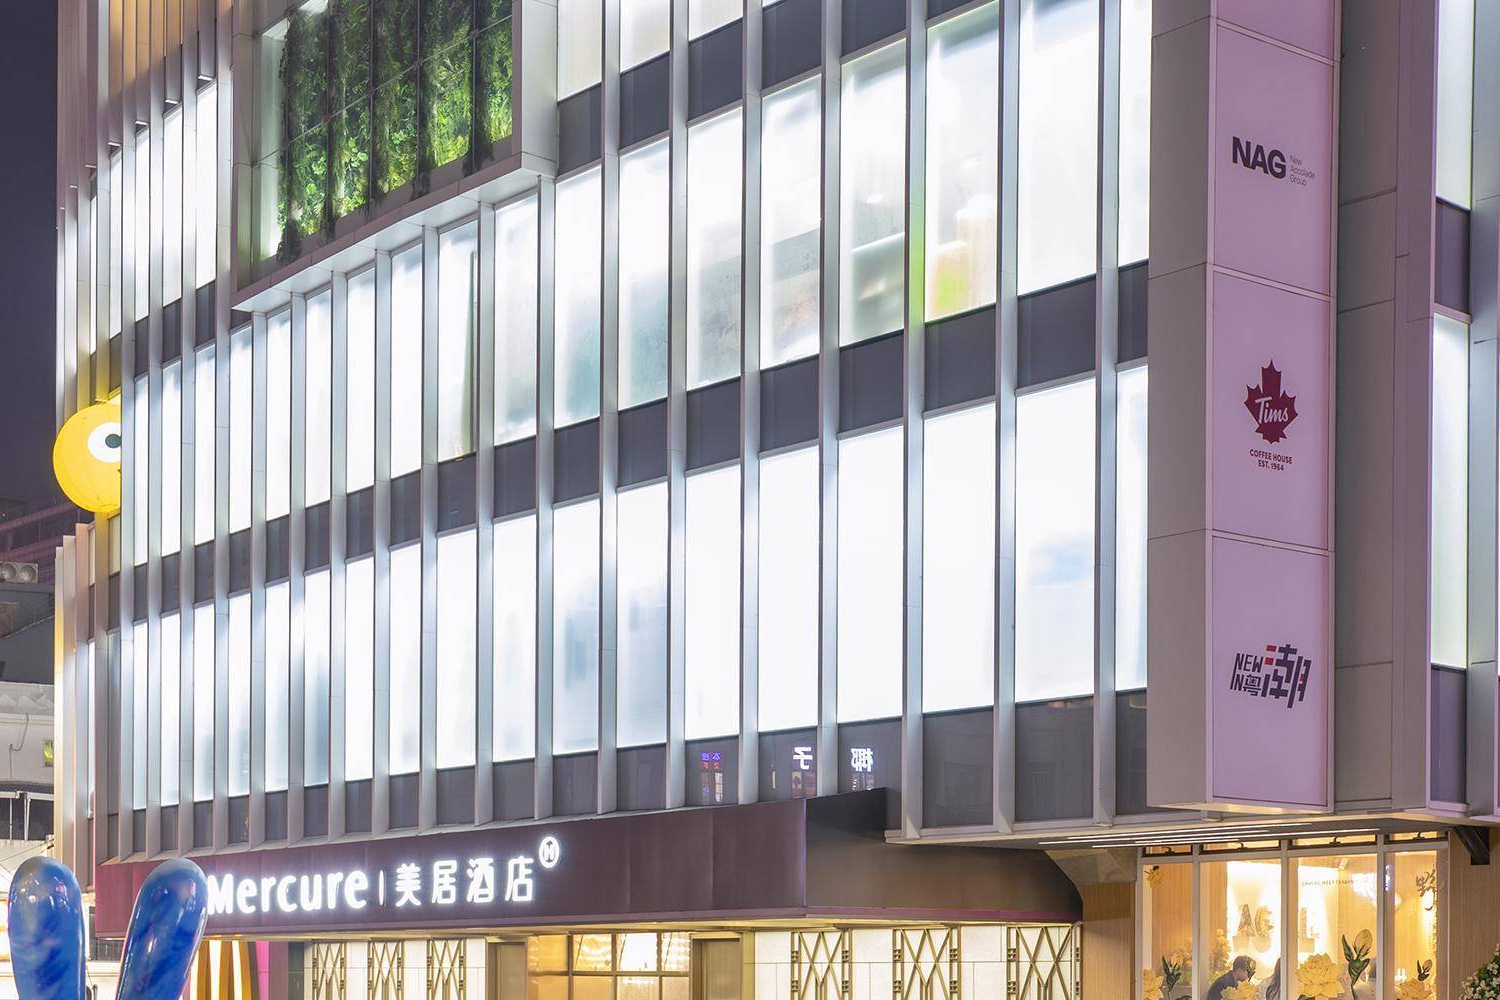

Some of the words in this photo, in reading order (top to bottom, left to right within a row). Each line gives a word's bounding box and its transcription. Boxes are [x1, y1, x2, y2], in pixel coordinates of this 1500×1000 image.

[1232, 136, 1287, 179] NAG
[1290, 155, 1303, 166] New
[1290, 174, 1308, 187] Group
[1254, 396, 1289, 425] Tims
[1249, 449, 1272, 461] COFFEE
[1273, 454, 1293, 464] HOUSE
[1258, 459, 1270, 469] EST.
[1234, 652, 1263, 673] NEW
[1261, 644, 1312, 709] 潮
[206, 868, 369, 915] Mercure
[395, 855, 535, 908] 美居酒店
